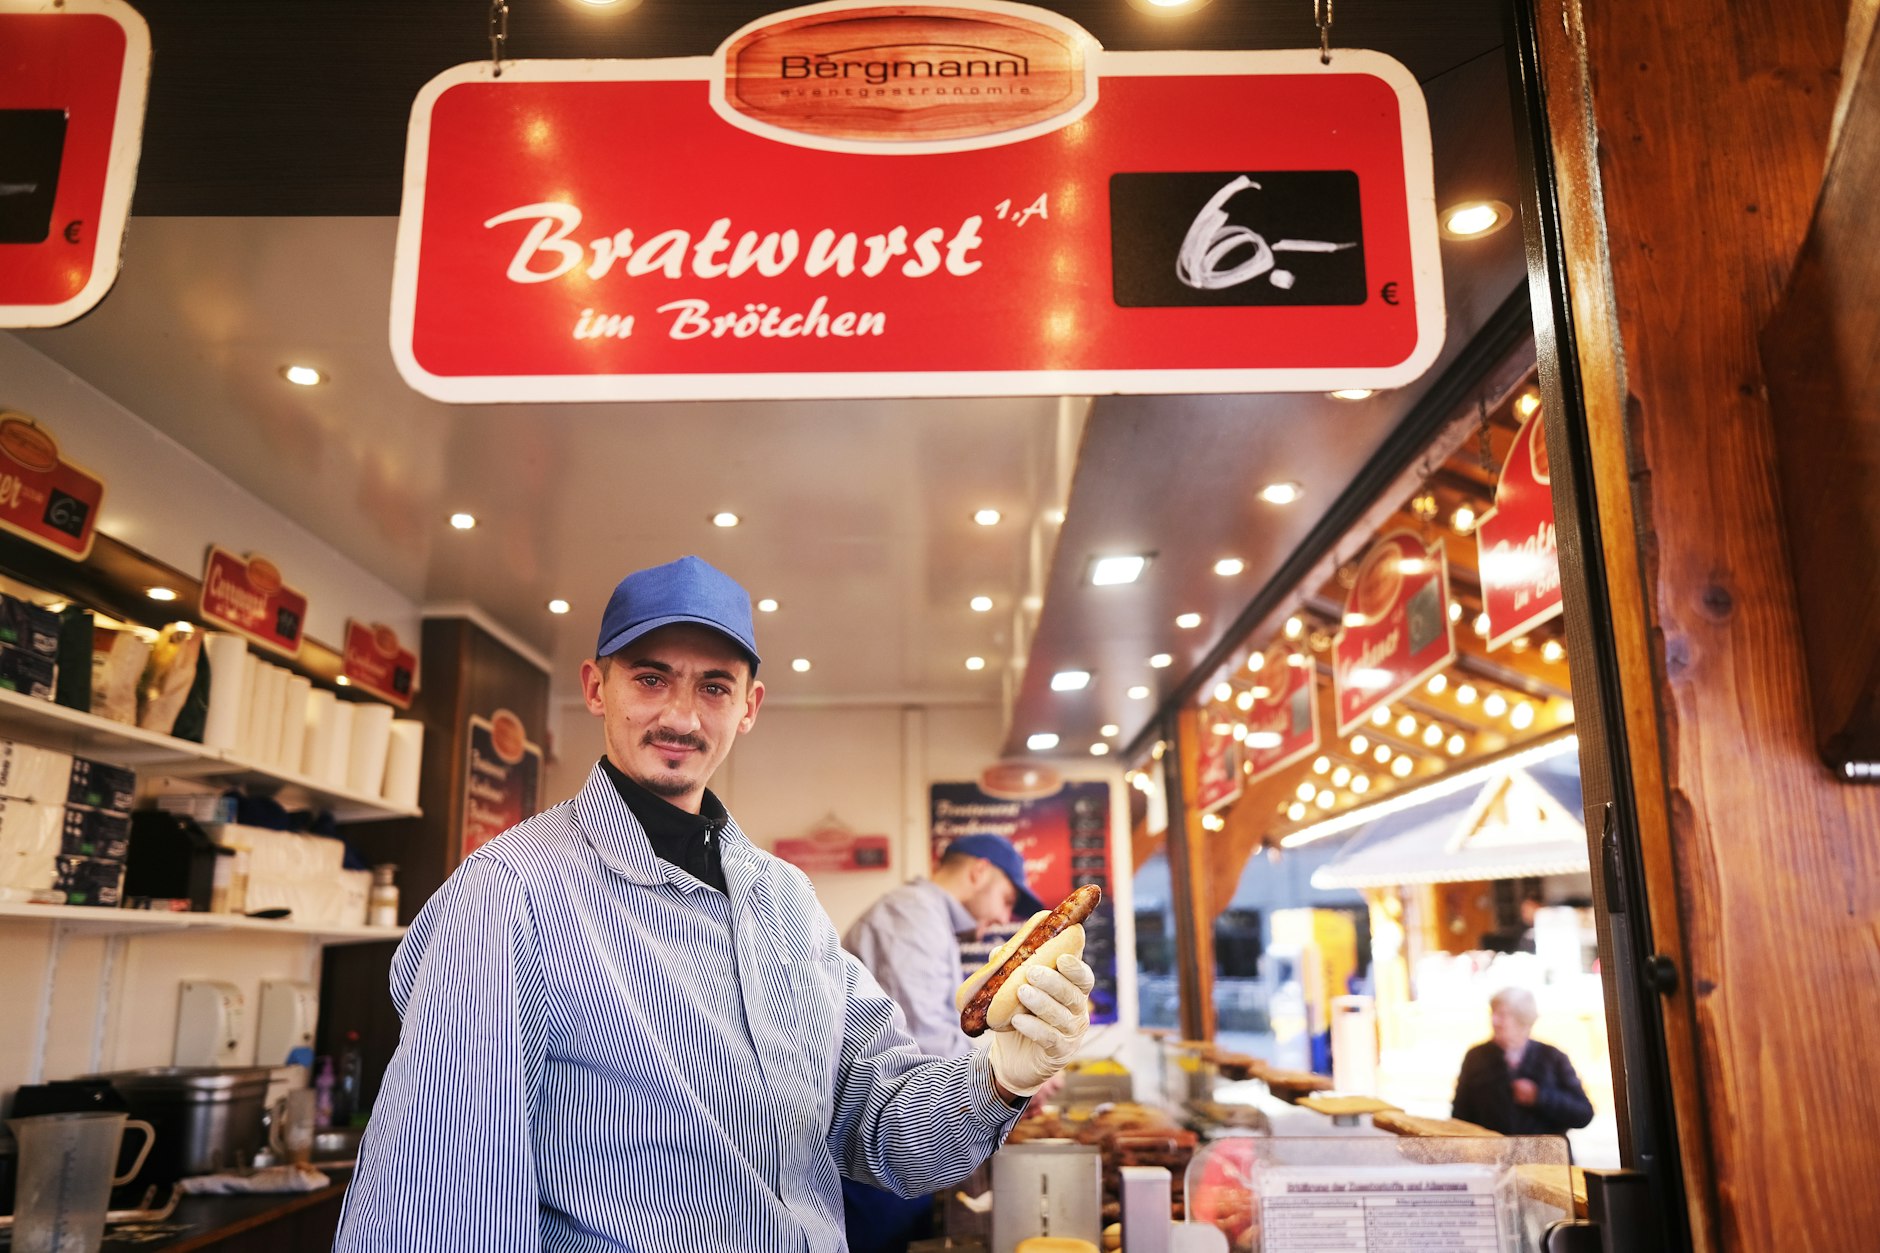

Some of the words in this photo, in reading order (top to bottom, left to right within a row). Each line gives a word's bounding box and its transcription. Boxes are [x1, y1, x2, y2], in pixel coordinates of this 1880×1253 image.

[780, 86, 1031, 98] eventgastronomie
[484, 201, 983, 284] Bratwurst
[1381, 282, 1399, 305] €
[573, 308, 635, 340] im
[656, 296, 887, 340] Brötchen
